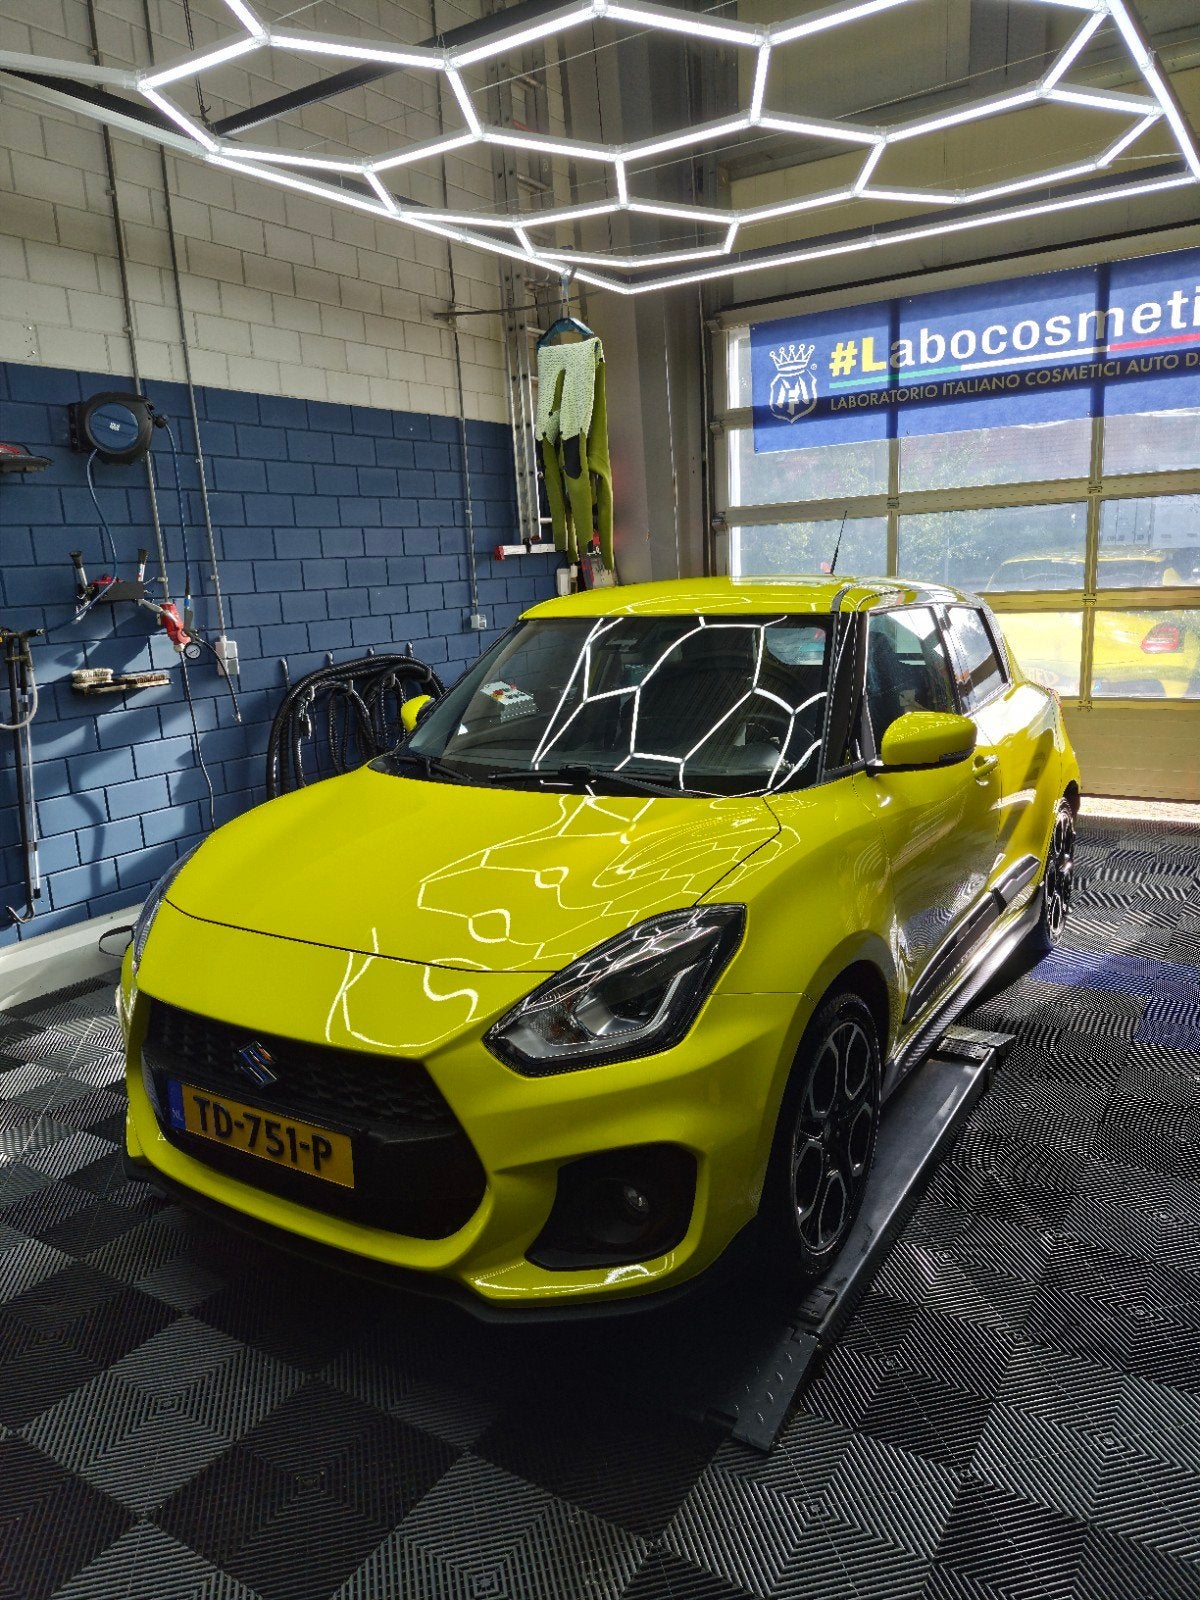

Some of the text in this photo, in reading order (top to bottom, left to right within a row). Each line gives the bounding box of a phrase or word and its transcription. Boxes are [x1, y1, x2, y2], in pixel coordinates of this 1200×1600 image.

[830, 352, 1200, 411] LABORATORIO ITALIANO COSMETICI AUTO D
[192, 1095, 333, 1172] TD-751-P
